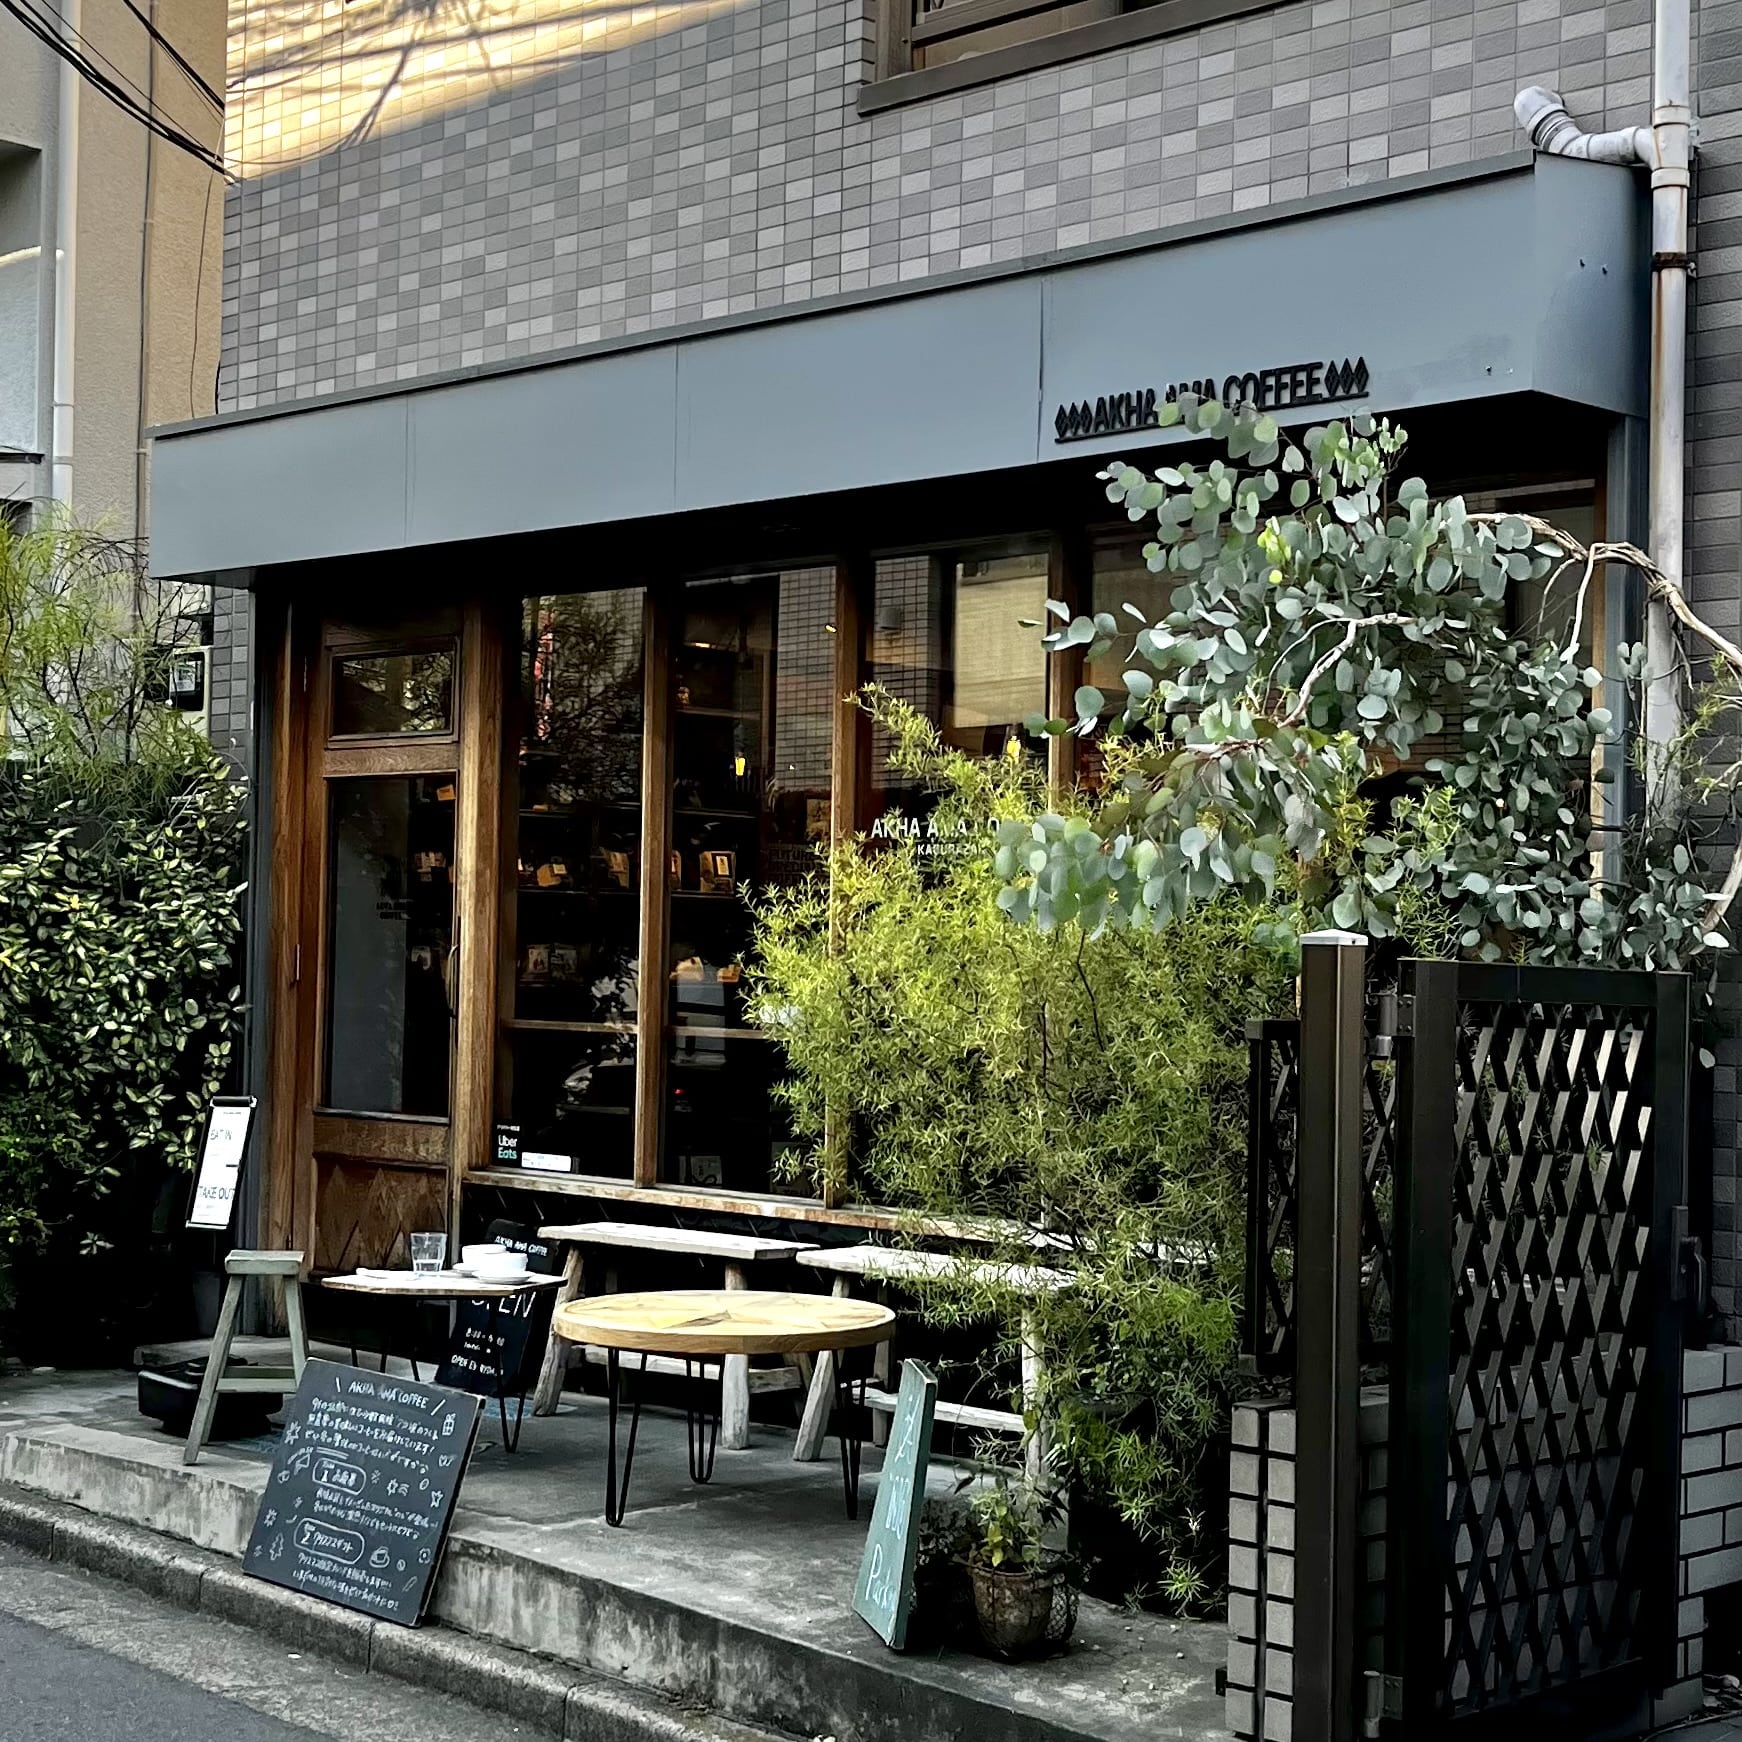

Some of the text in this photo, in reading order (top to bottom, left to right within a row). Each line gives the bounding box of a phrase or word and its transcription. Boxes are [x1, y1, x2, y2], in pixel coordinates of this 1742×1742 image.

[1094, 387, 1159, 433] AKHA
[1223, 362, 1323, 416] COFFEE
[498, 1134, 518, 1148] Uber
[498, 1147, 518, 1160] Eats
[398, 1391, 430, 1409] COFFEE
